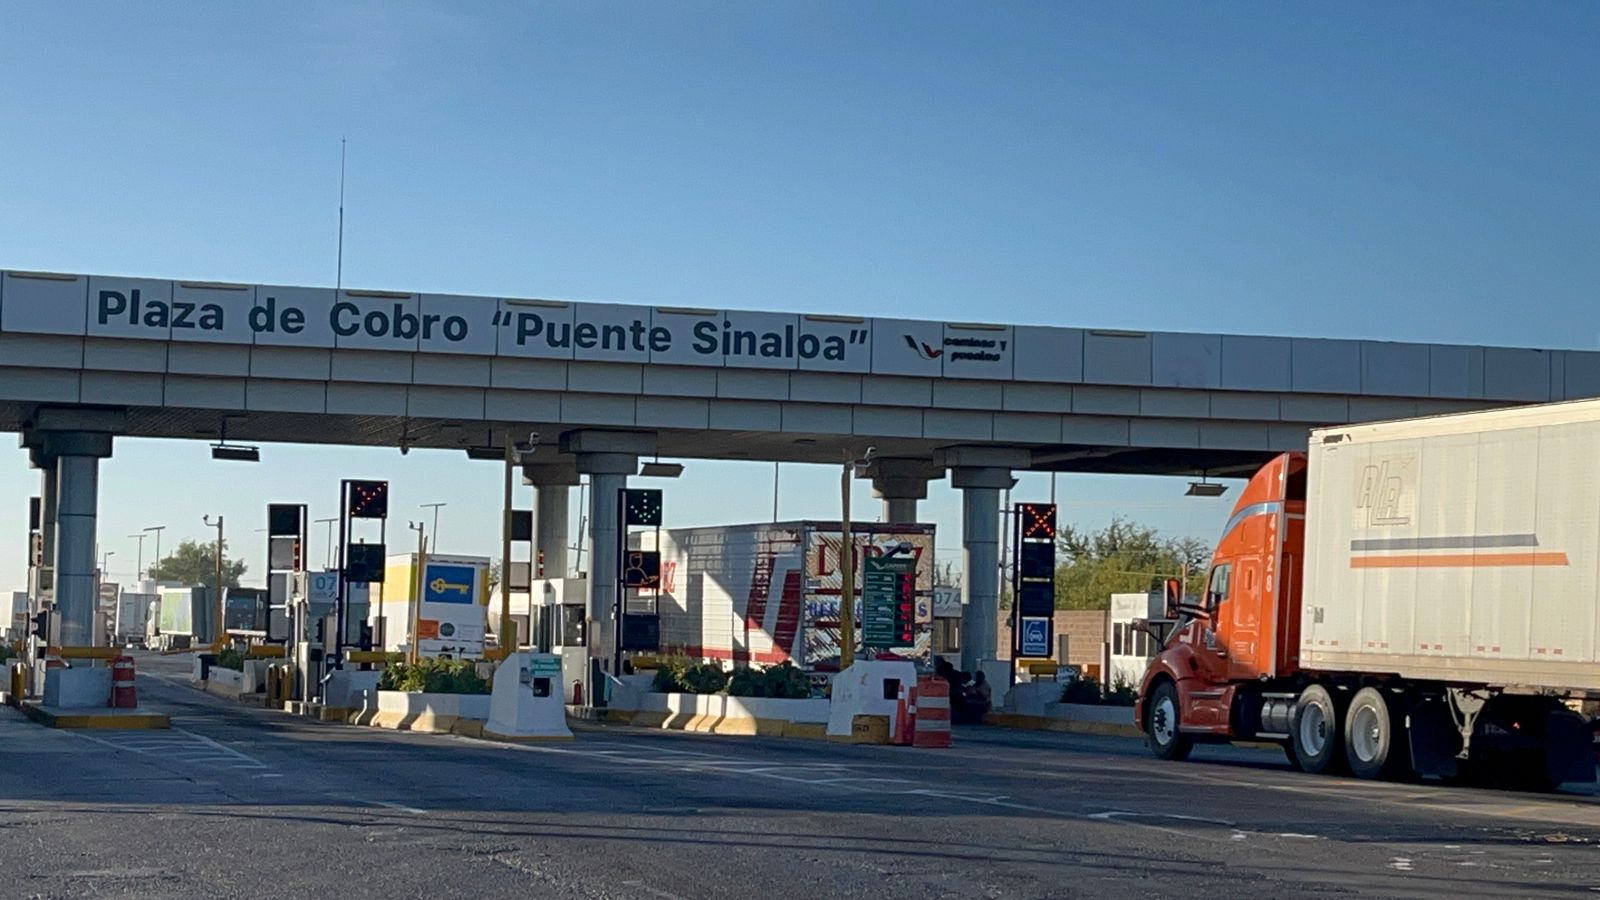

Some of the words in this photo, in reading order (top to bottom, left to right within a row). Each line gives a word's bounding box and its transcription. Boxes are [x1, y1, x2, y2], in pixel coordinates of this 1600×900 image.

[98, 289, 224, 331] Plaza
[248, 297, 305, 334] de
[330, 302, 469, 342] Cobro
[1265, 513, 1277, 593] 4128
